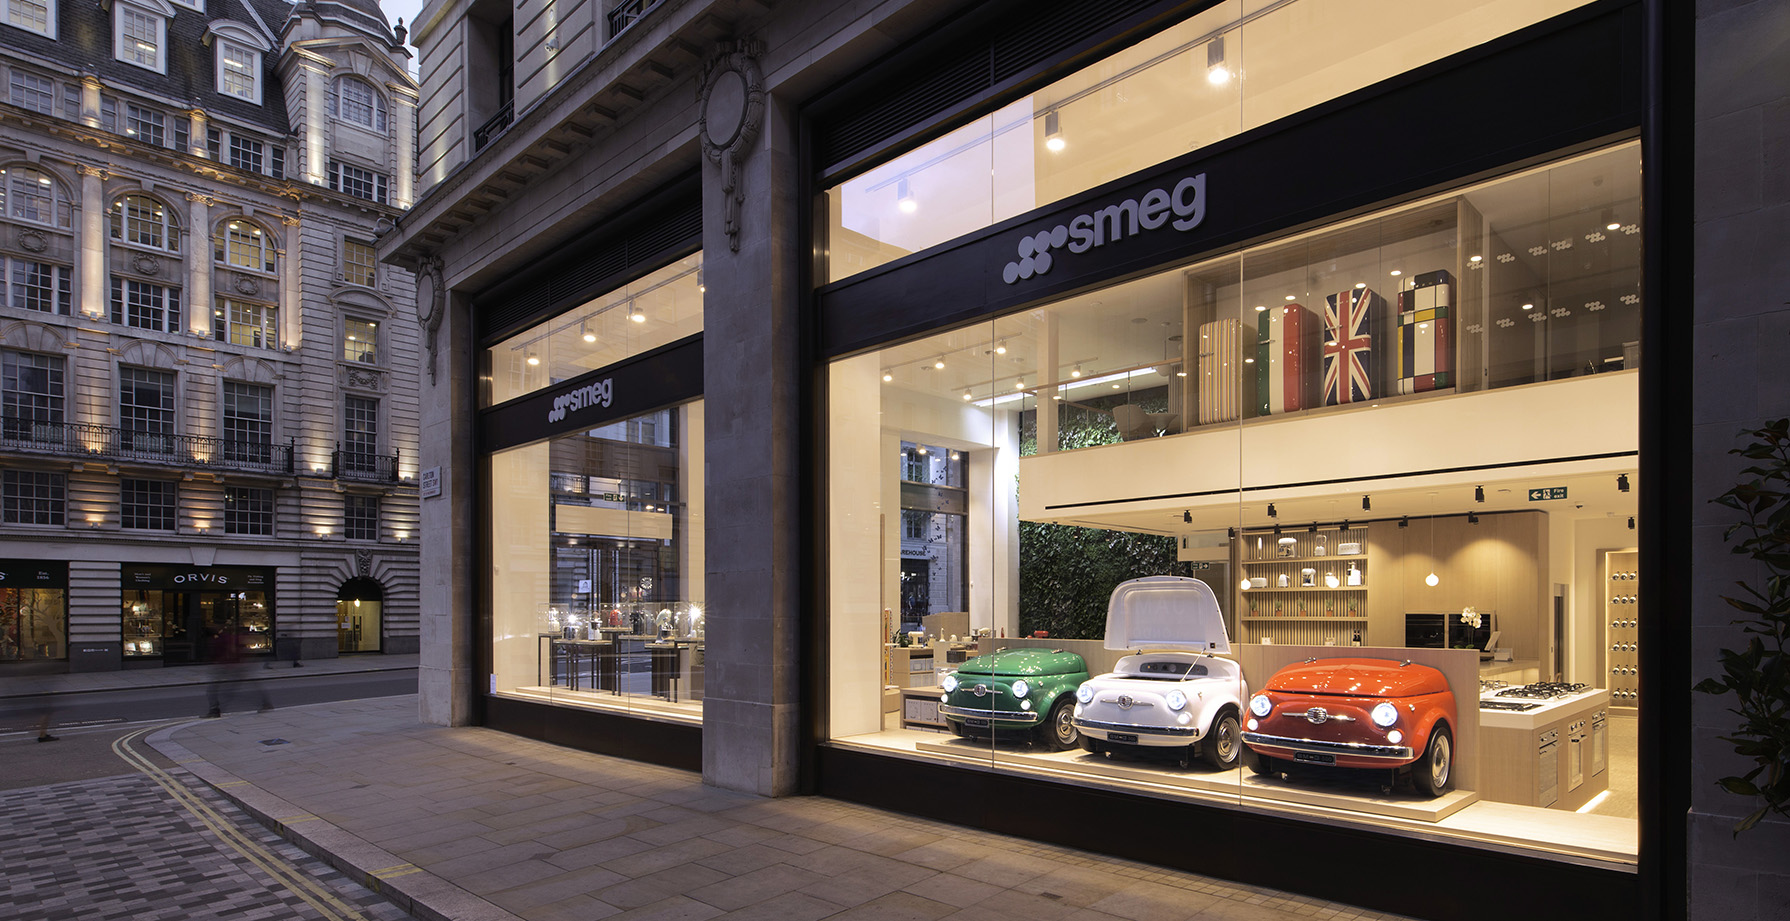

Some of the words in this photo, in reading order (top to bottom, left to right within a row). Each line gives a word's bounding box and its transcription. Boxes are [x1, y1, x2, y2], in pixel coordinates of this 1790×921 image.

[1067, 173, 1207, 254] smeg
[569, 377, 613, 412] smeg
[173, 573, 228, 584] ORVIS
